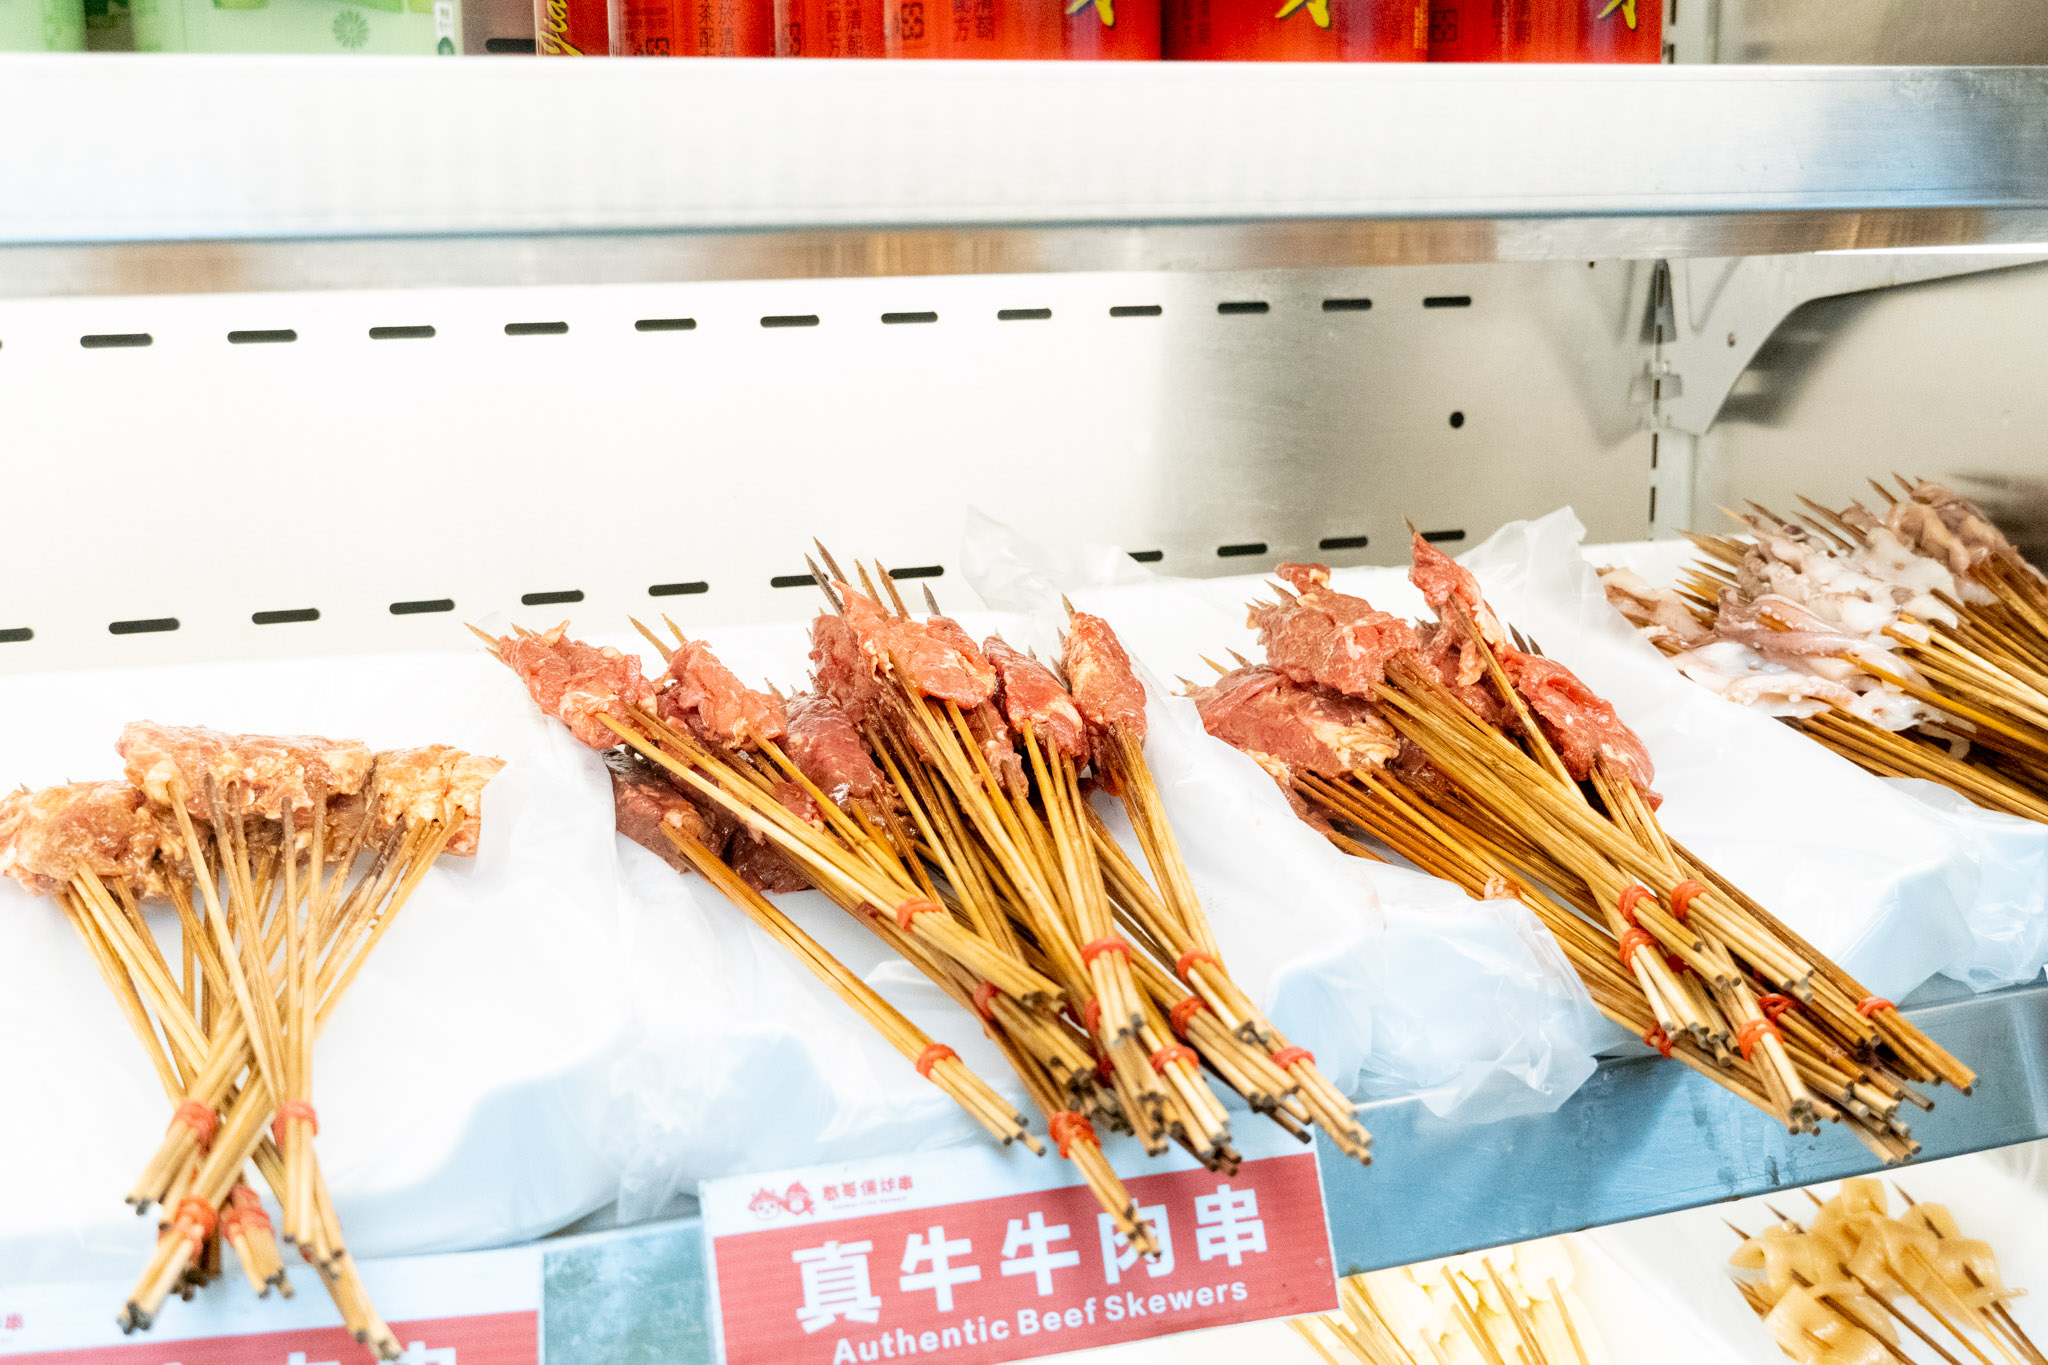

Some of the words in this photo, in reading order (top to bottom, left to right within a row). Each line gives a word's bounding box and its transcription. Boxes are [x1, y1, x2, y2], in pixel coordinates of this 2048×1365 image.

[792, 1184, 1268, 1335] 真牛牛肉串
[832, 1315, 1010, 1365] Authentic
[1017, 1298, 1097, 1336] Beef
[1105, 1281, 1249, 1321] Skewers
